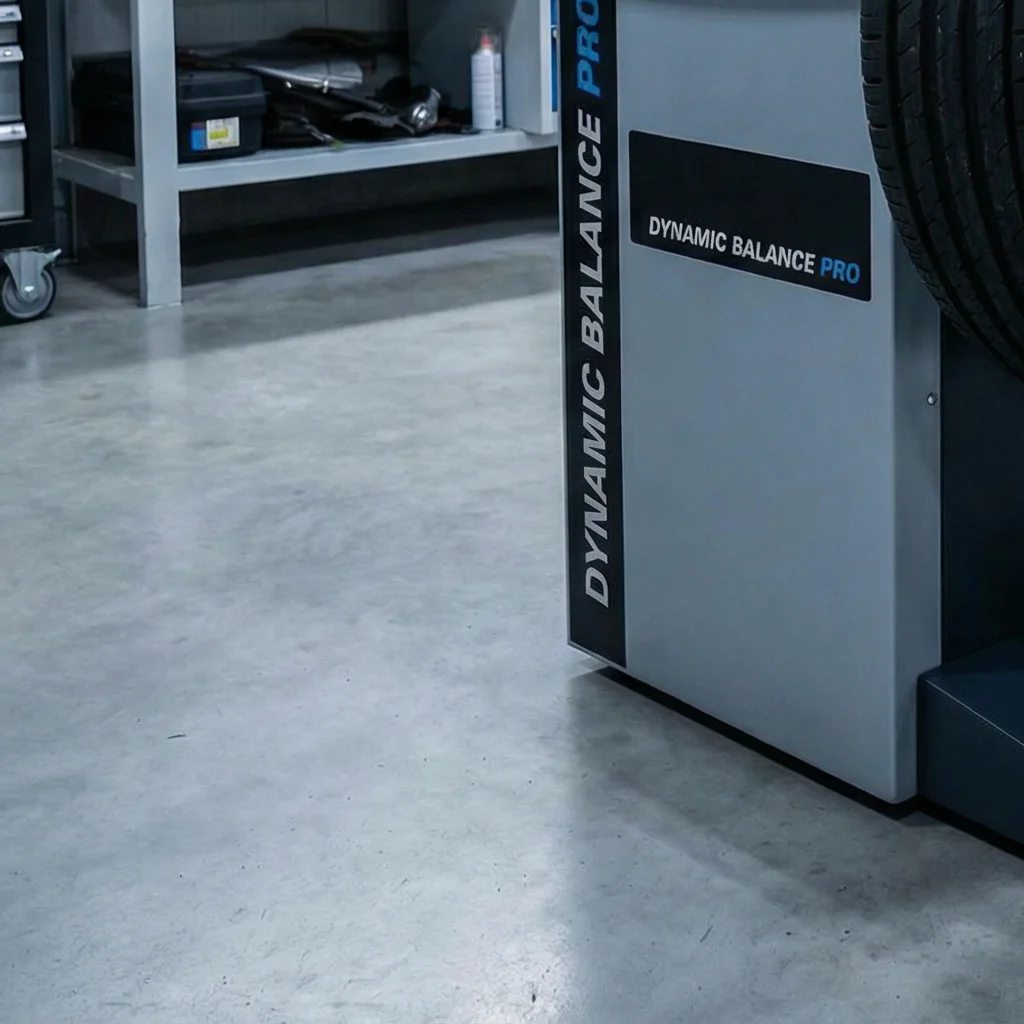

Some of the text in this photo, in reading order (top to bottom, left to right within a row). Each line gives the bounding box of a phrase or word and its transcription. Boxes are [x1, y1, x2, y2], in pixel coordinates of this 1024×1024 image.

[578, 108, 605, 356] BALANCE
[648, 215, 861, 285] DYNAMIC BALANCE PRO
[581, 362, 609, 609] DYNAMIC
